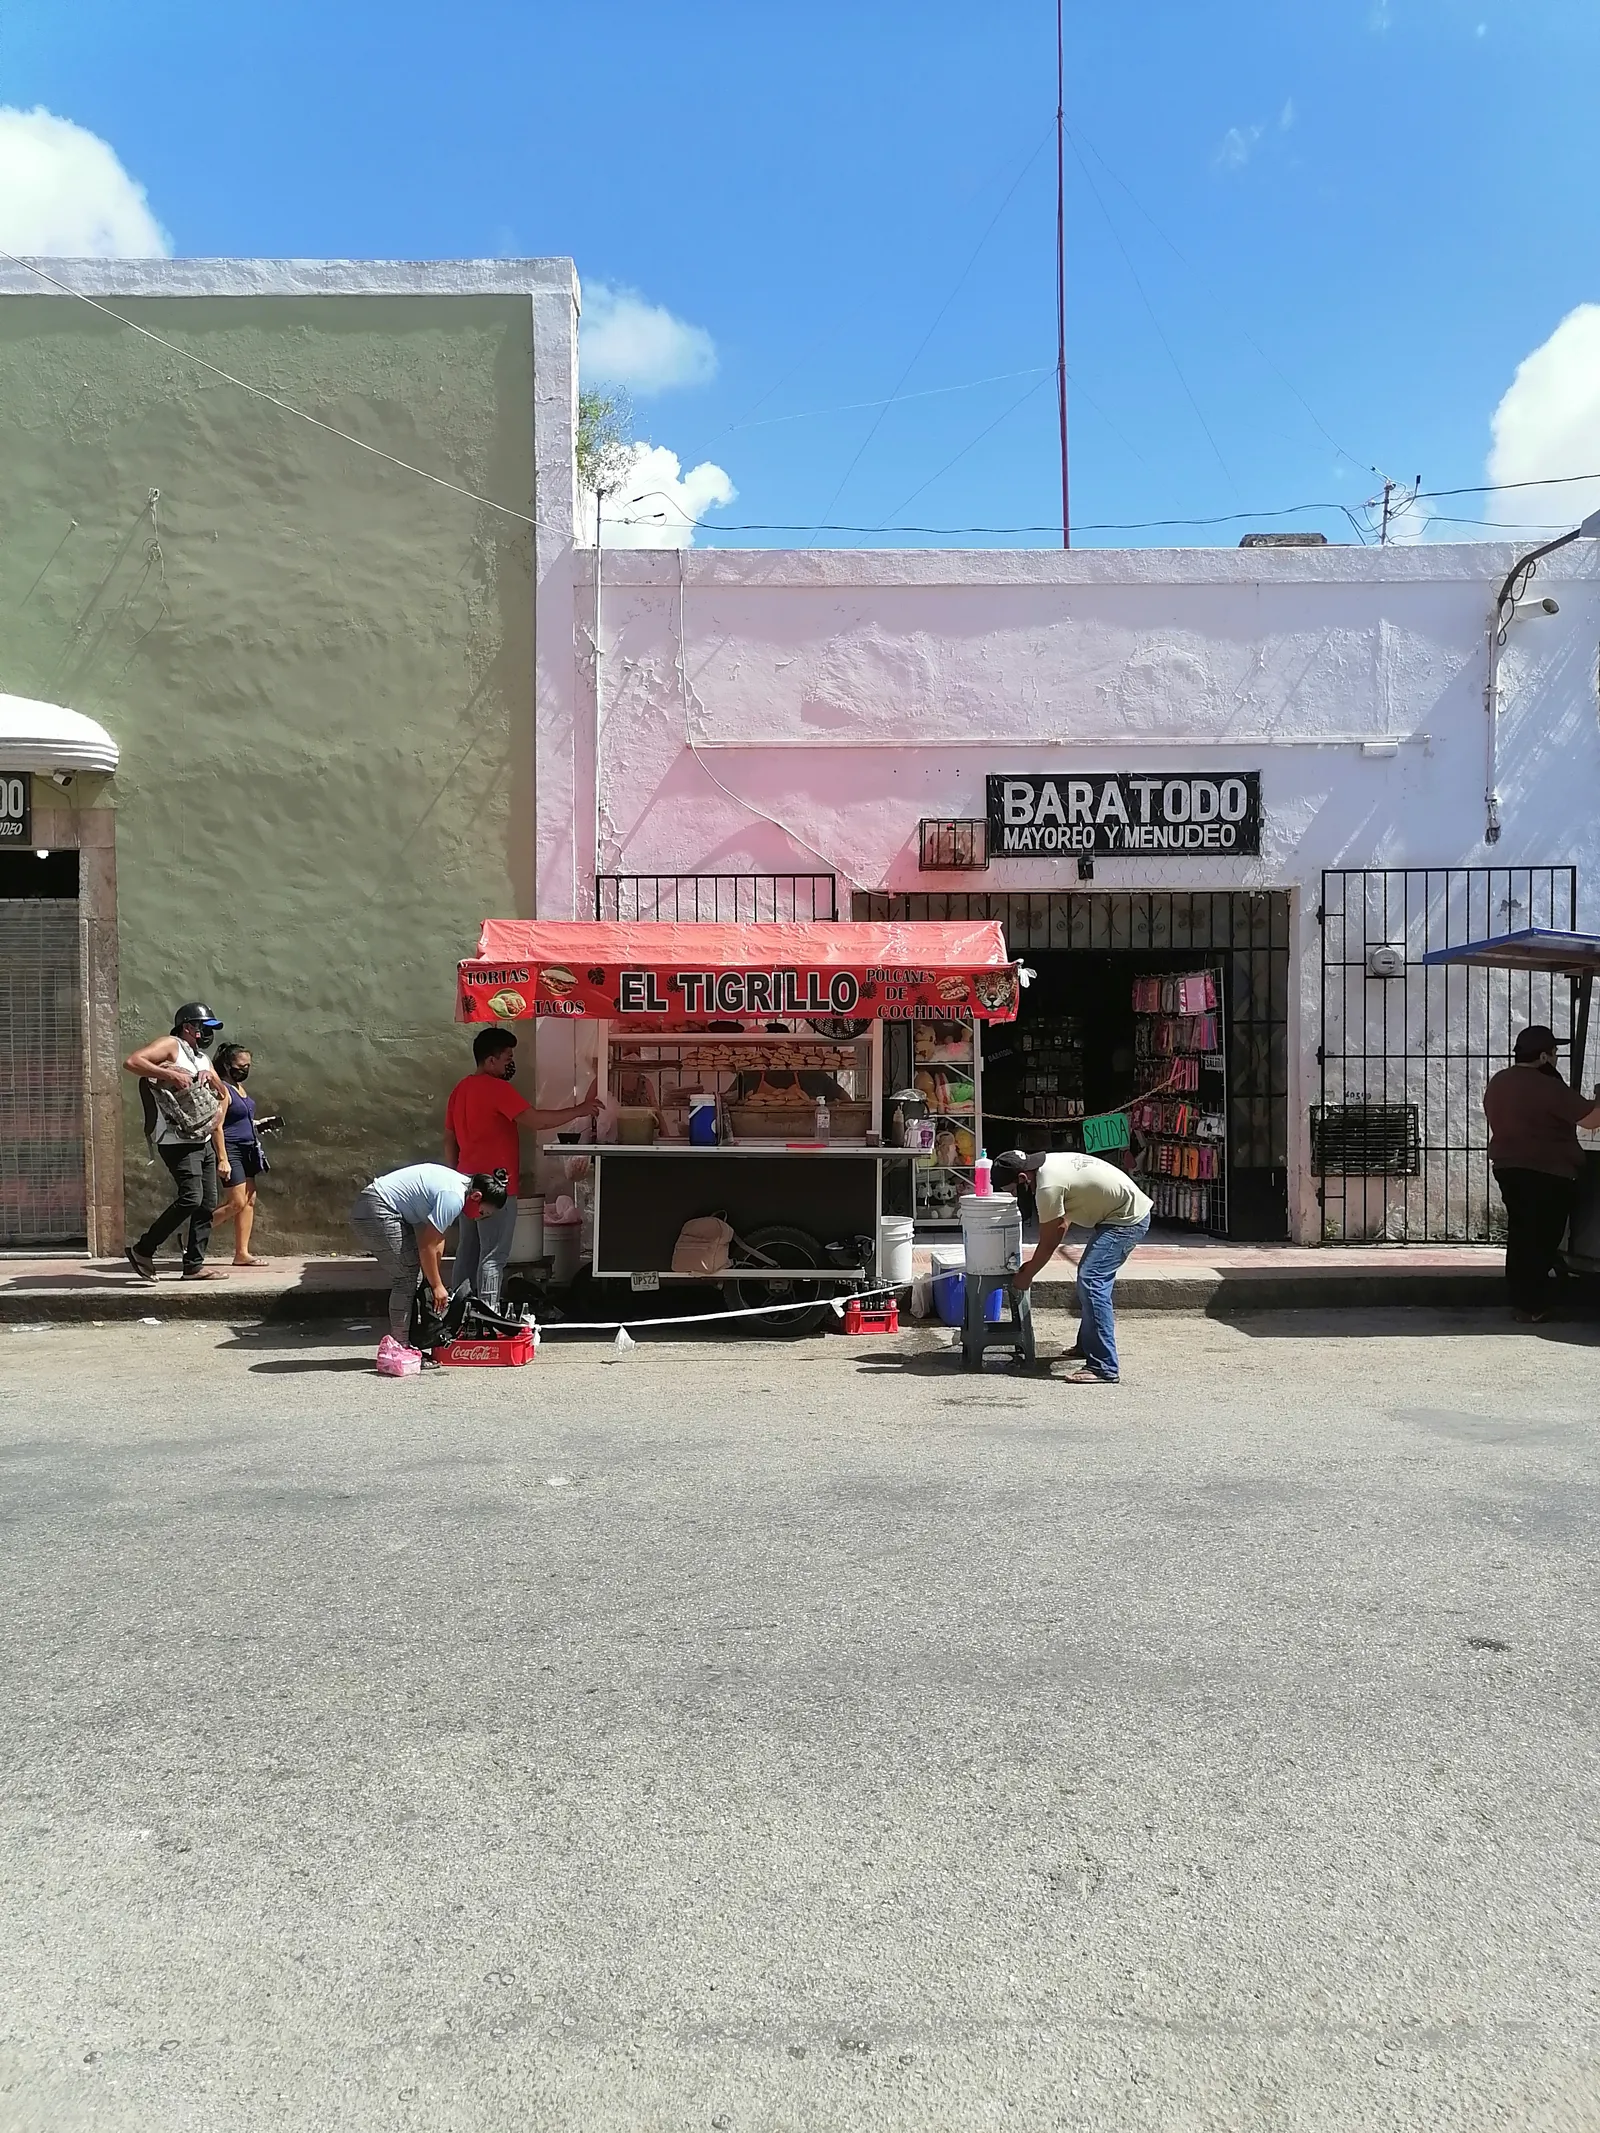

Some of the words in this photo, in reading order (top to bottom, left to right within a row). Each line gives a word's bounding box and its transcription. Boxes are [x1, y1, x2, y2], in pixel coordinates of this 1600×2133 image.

[1003, 779, 1247, 825] BARATODO
[0, 822, 23, 835] DEO
[1003, 826, 1096, 850] MAYOREO
[1103, 825, 1120, 849] Y
[1125, 824, 1237, 849] MENUDEO
[467, 968, 529, 985] TORTAS
[865, 967, 937, 983] POLCANES
[620, 971, 668, 1012] EL
[677, 971, 860, 1013] TIGRILLO
[885, 986, 908, 1001] DE
[533, 1000, 586, 1015] TACOS
[877, 1004, 974, 1020] COCHINITA
[1084, 1117, 1129, 1150] SALIDA
